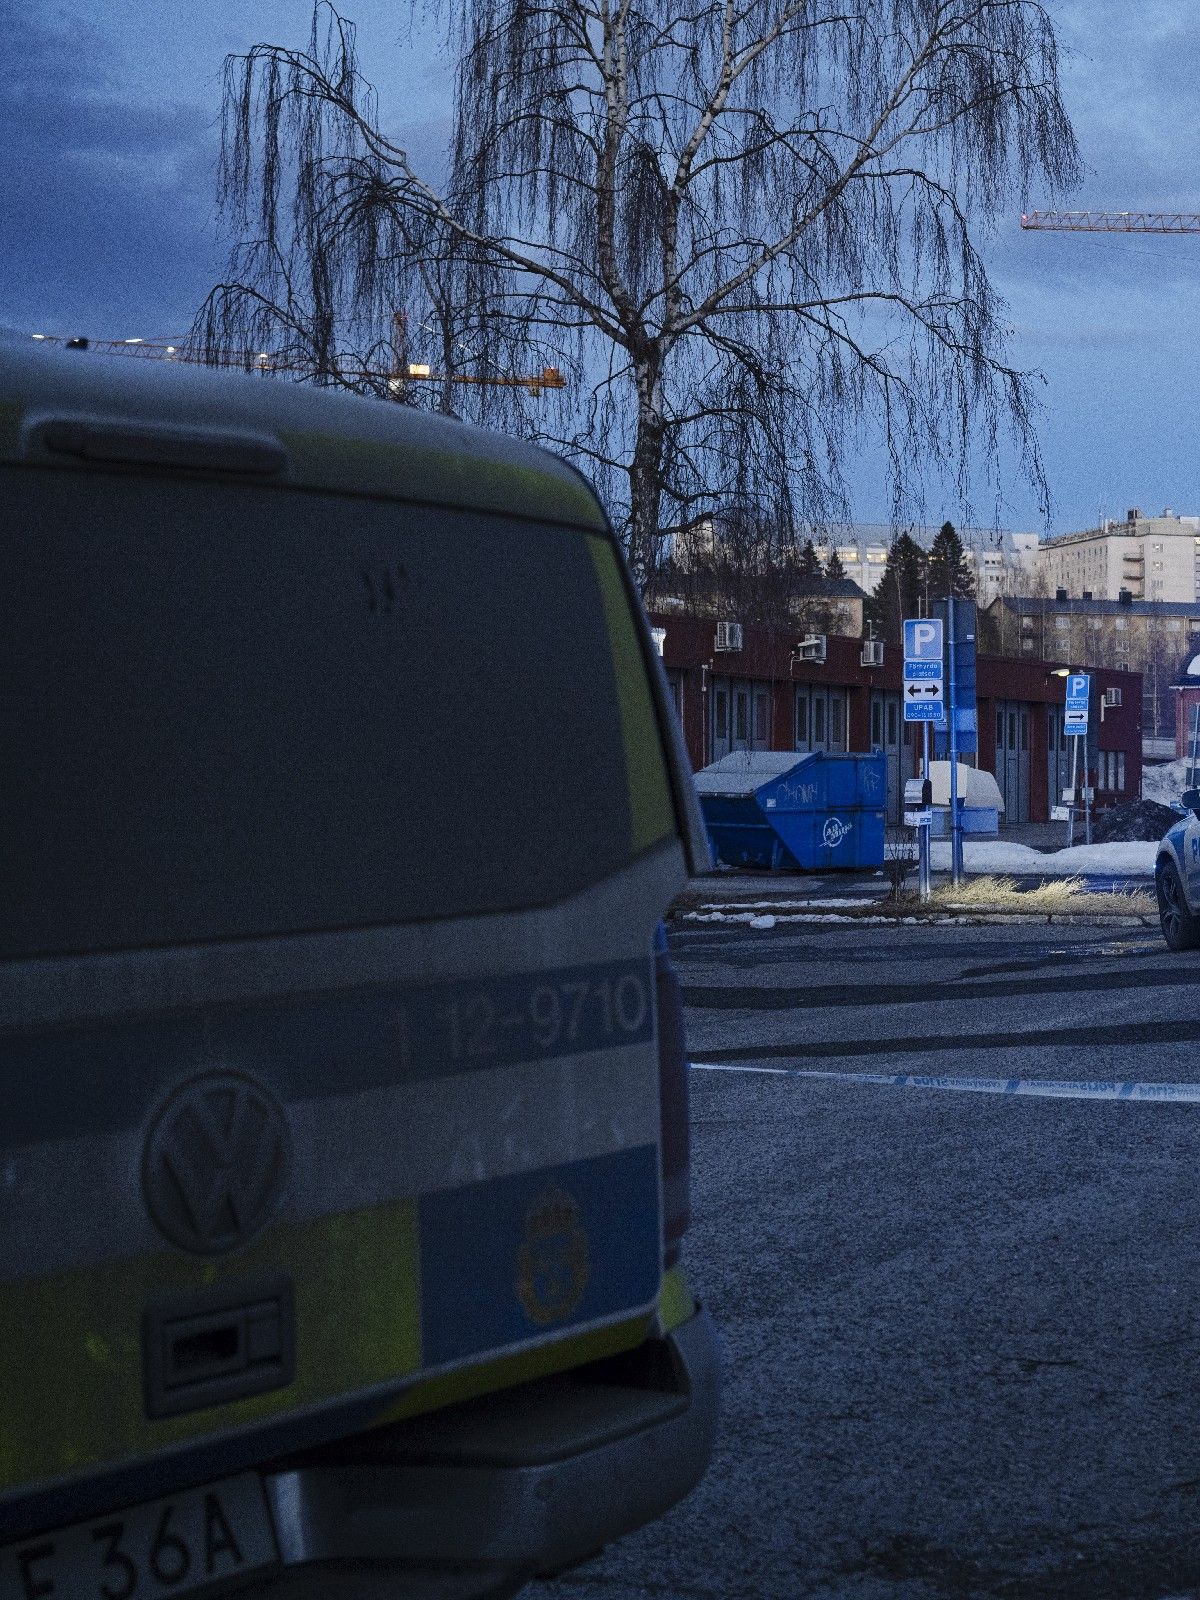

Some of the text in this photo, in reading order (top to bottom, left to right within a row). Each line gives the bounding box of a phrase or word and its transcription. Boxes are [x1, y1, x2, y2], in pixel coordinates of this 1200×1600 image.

[914, 623, 936, 655] P
[1072, 677, 1086, 697] P
[443, 973, 647, 1061] 12-9710
[92, 1492, 244, 1600] 36A
